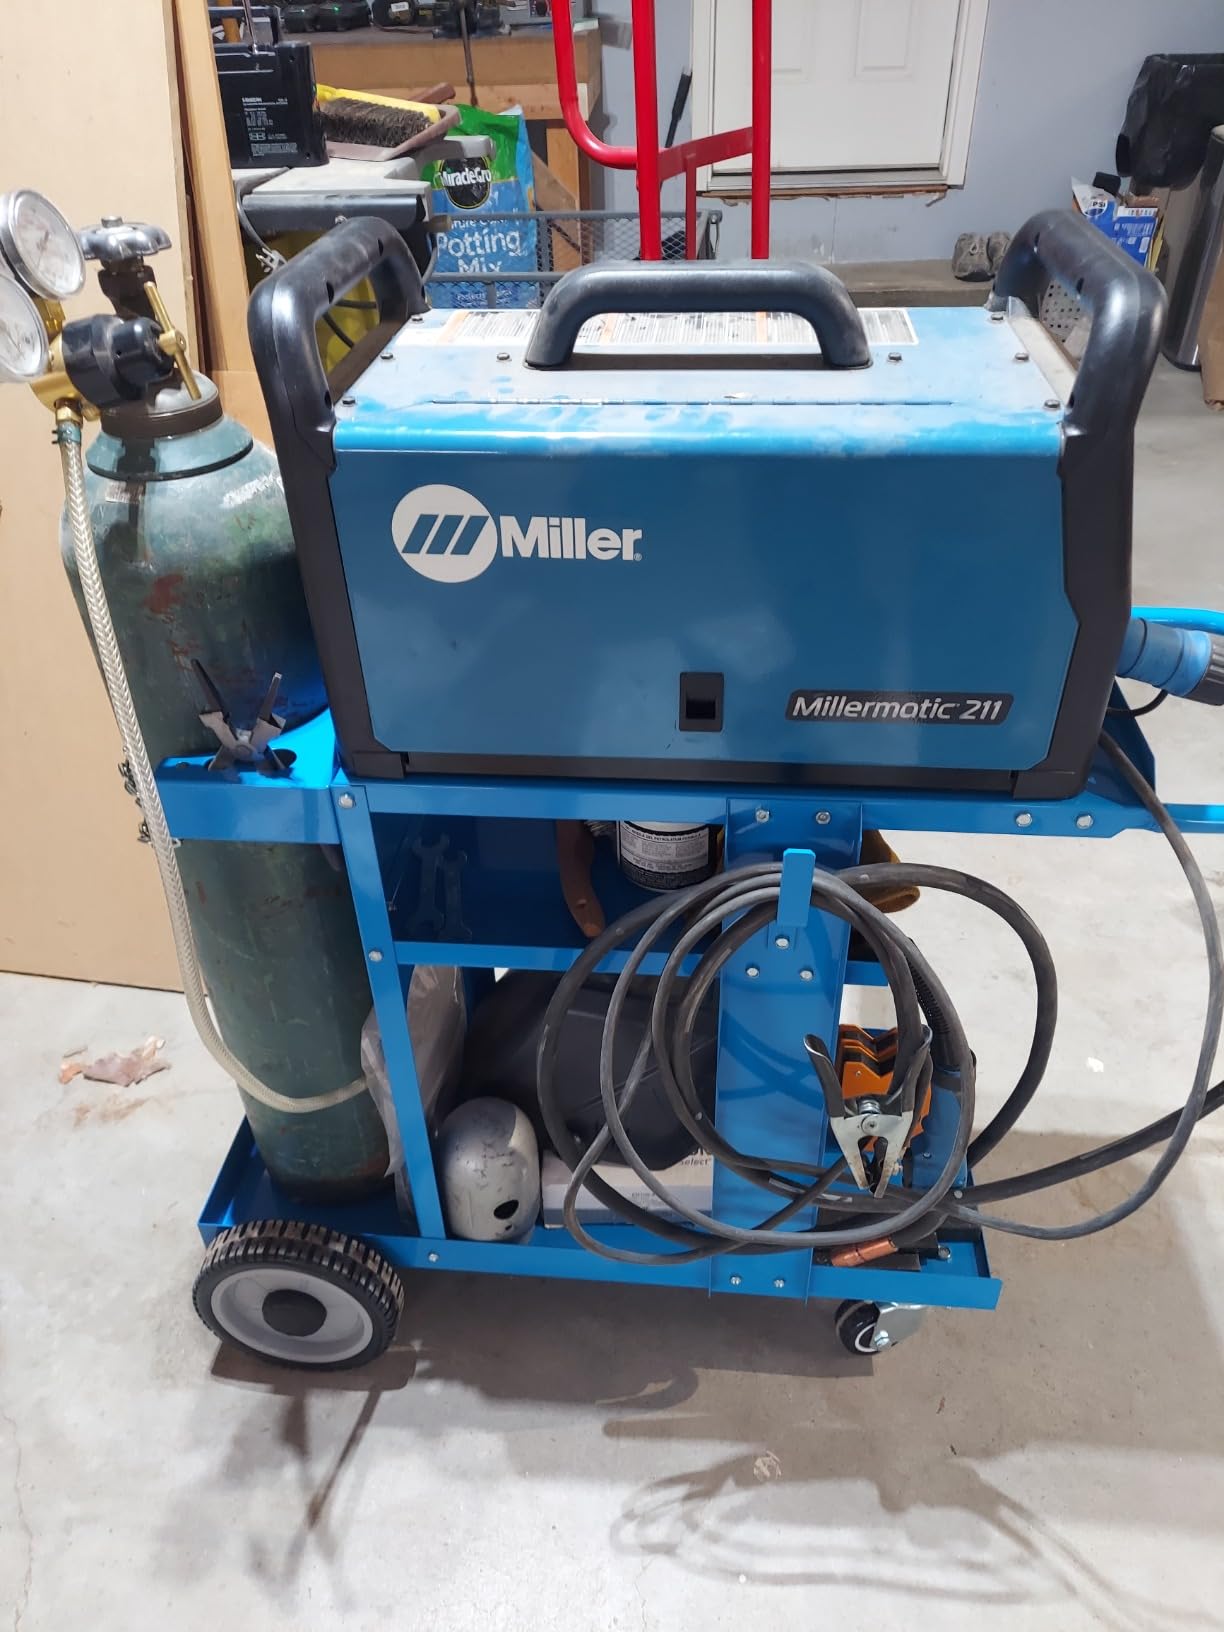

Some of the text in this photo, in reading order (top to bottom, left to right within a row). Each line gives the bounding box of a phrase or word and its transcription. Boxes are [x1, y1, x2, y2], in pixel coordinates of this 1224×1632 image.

[436, 228, 520, 258] Potting
[457, 256, 502, 273] Mix
[500, 515, 642, 561] Miller
[792, 696, 1003, 720] Millermatic 211
